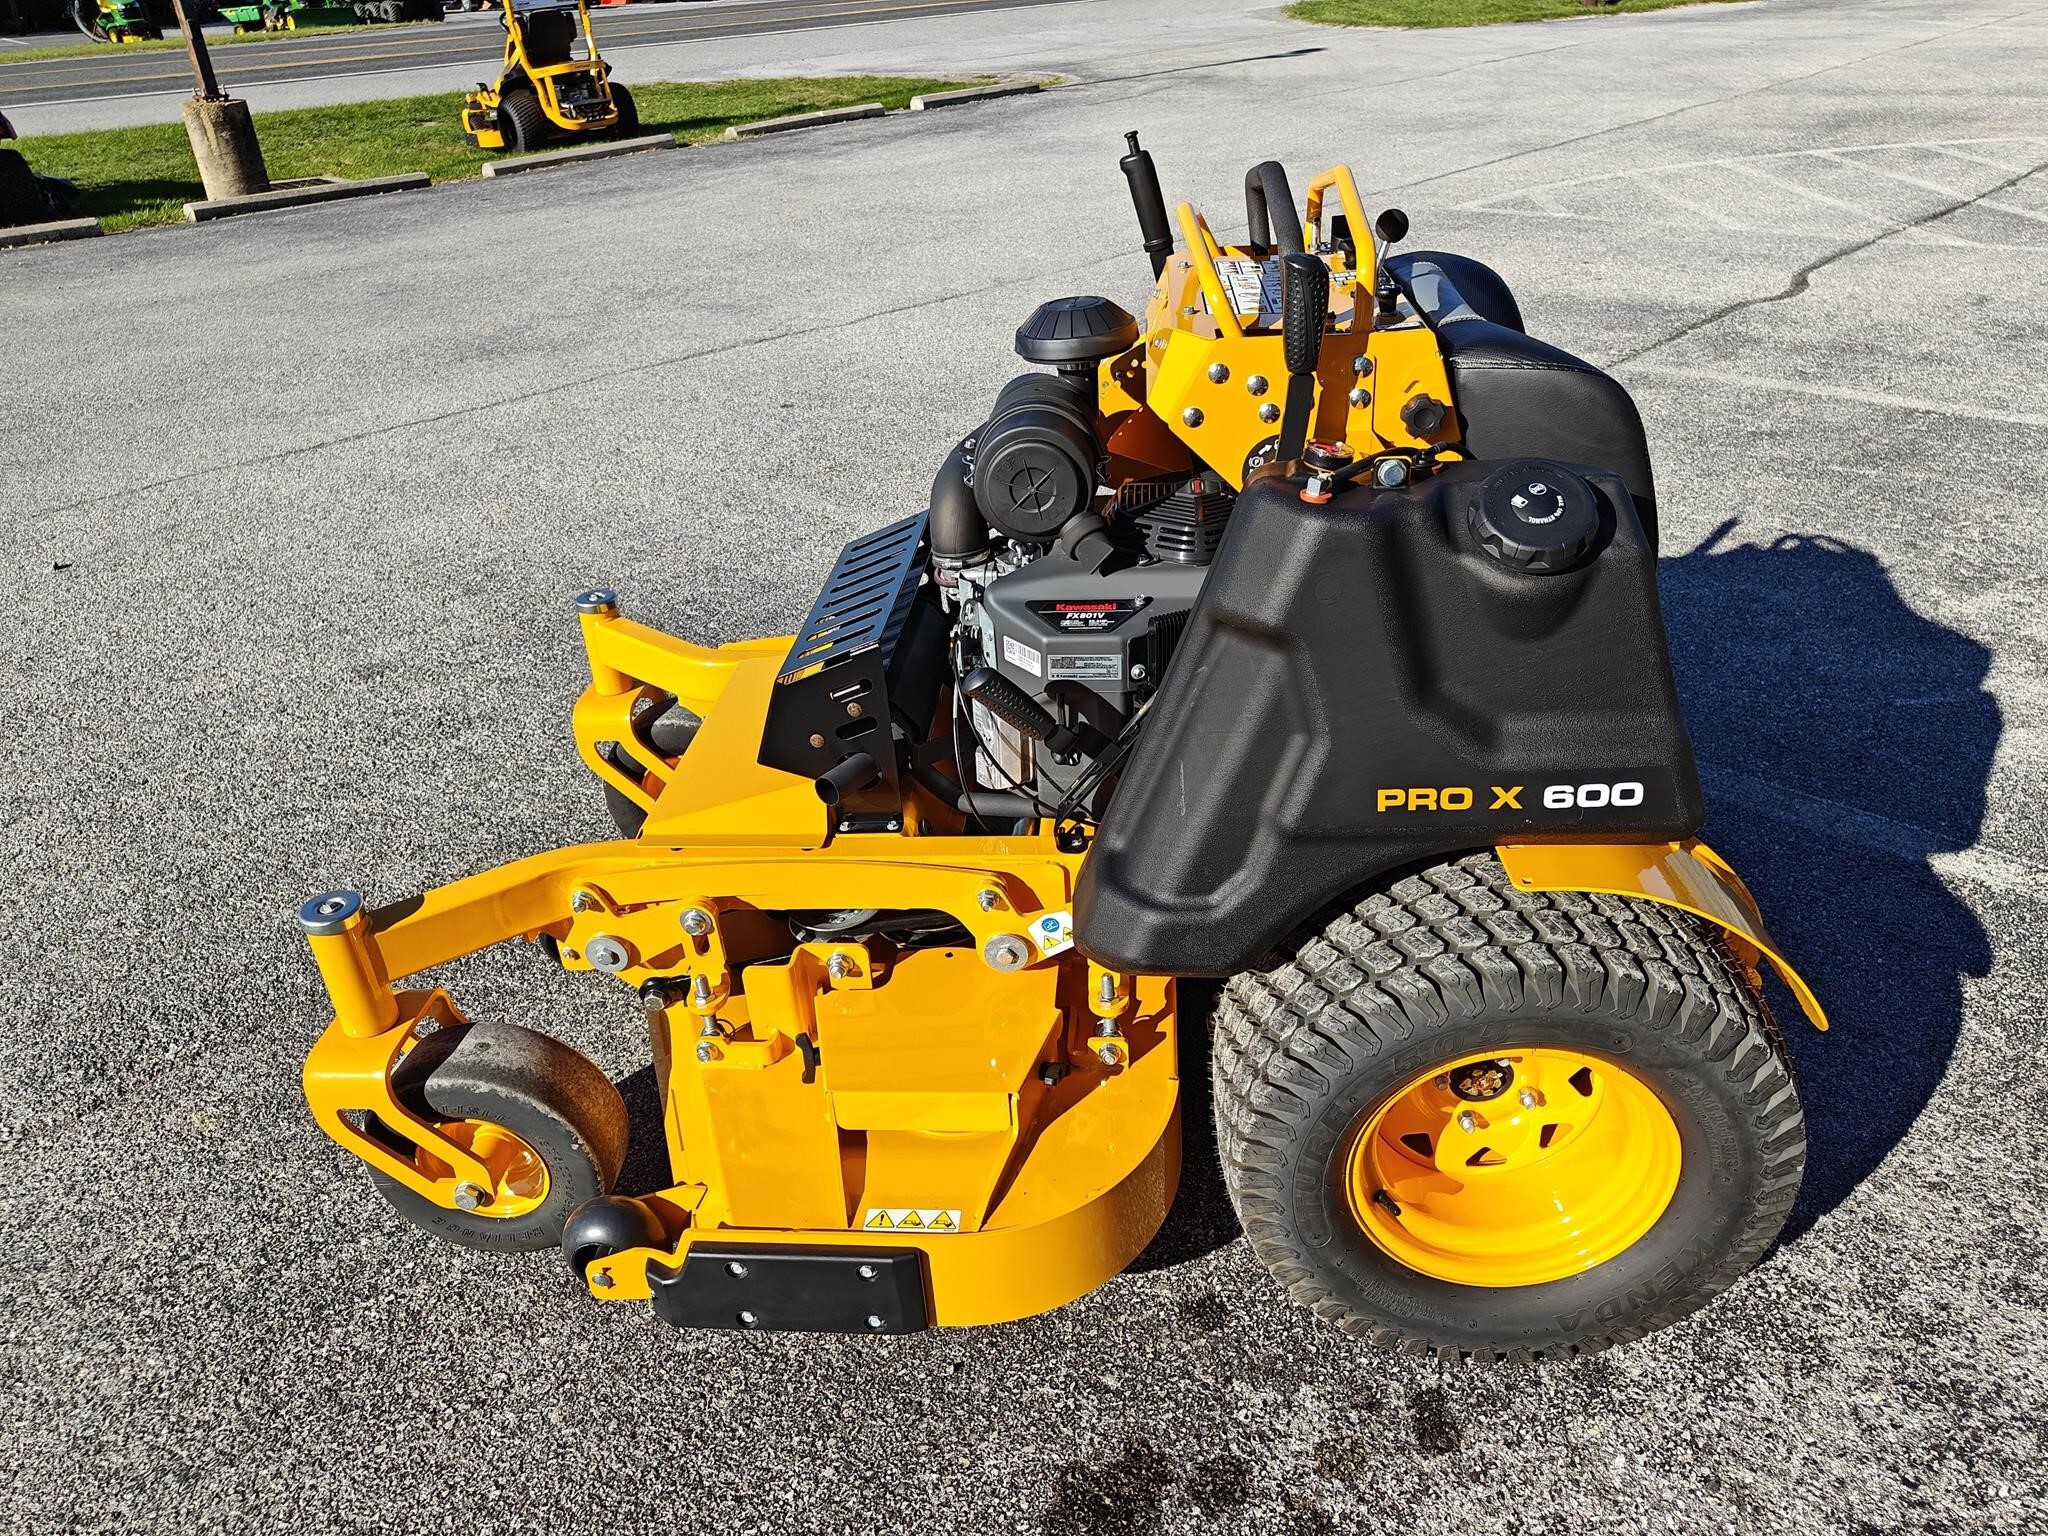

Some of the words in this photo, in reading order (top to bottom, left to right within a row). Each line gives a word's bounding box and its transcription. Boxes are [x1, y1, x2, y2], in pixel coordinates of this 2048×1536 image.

[1055, 603, 1117, 611] Kawasaki
[1377, 786, 1473, 812] PRO
[1488, 785, 1524, 810] X
[1543, 782, 1645, 809] 600
[1552, 1233, 1714, 1334] KENDA
